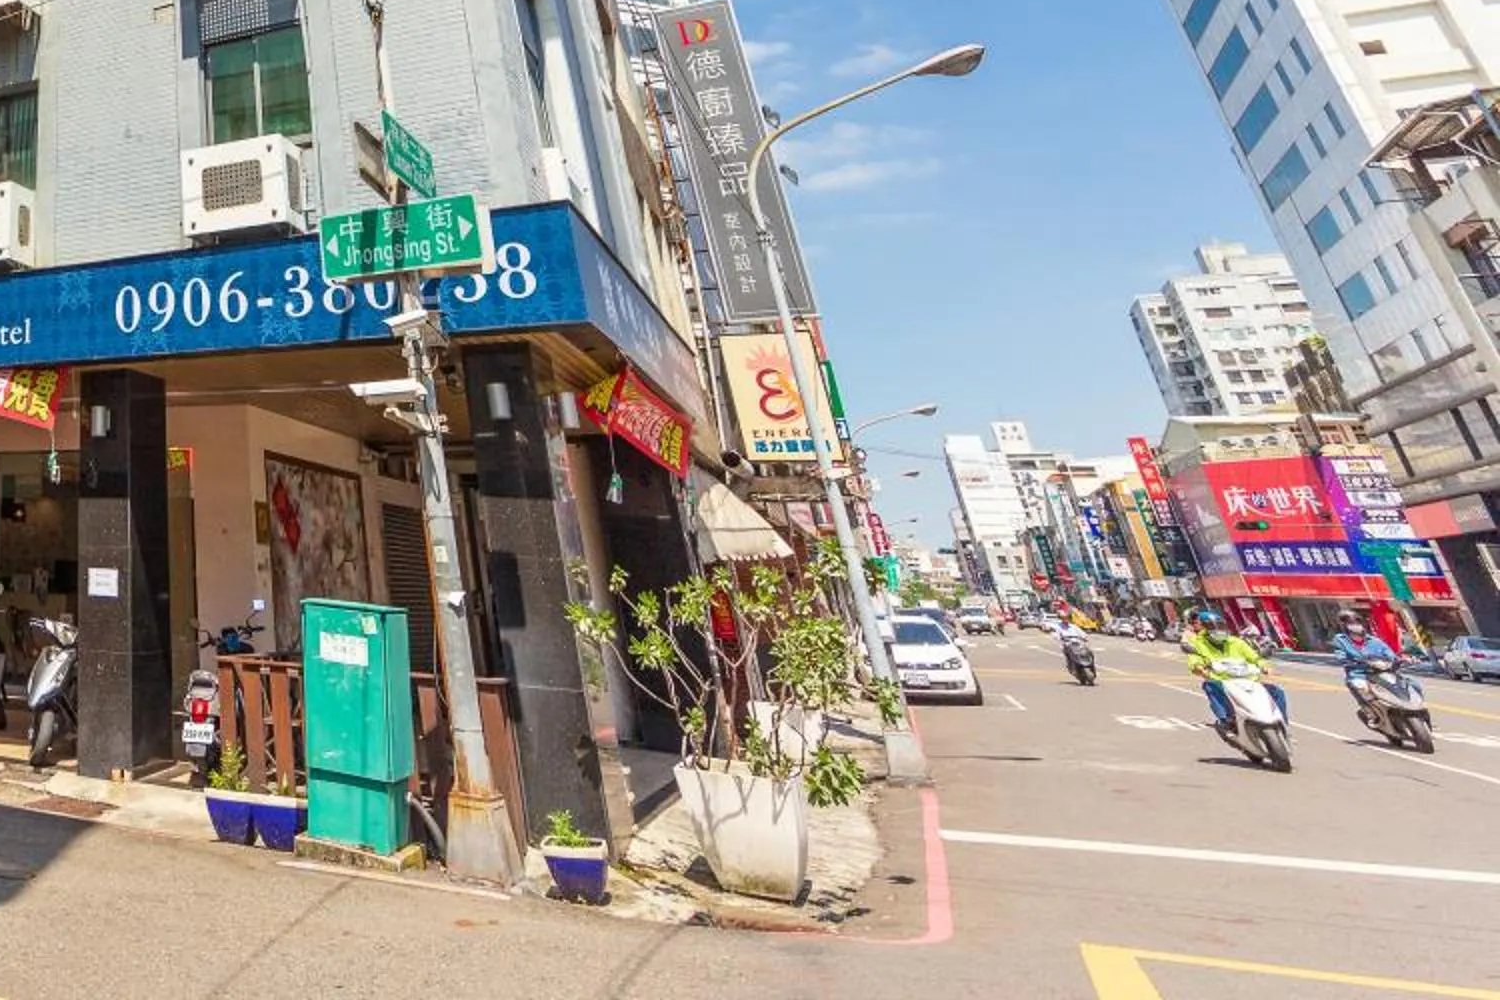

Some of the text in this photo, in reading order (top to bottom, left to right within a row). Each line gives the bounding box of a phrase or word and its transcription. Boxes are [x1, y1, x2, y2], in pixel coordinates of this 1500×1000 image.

[338, 202, 453, 245] 中興街
[343, 232, 461, 268] Jhongsing St.
[114, 242, 538, 334] 0906-3838
